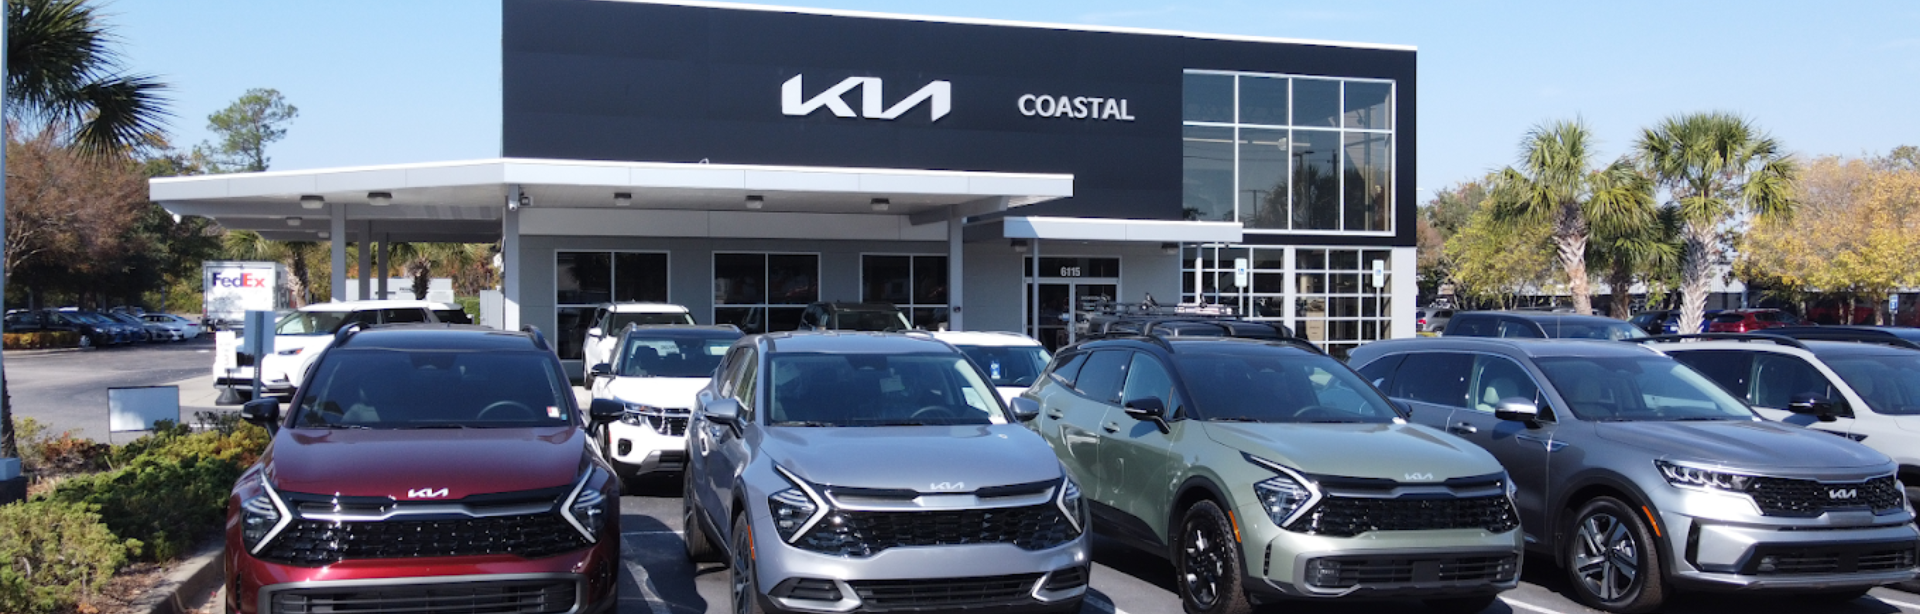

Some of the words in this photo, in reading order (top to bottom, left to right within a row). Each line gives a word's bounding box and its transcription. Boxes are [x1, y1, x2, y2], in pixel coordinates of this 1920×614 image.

[781, 73, 950, 122] KIA
[1018, 94, 1135, 120] COASTAL
[1060, 266, 1080, 276] 6115
[212, 272, 265, 288] FedEx
[407, 488, 449, 498] KIA
[1829, 488, 1857, 499] KIA
